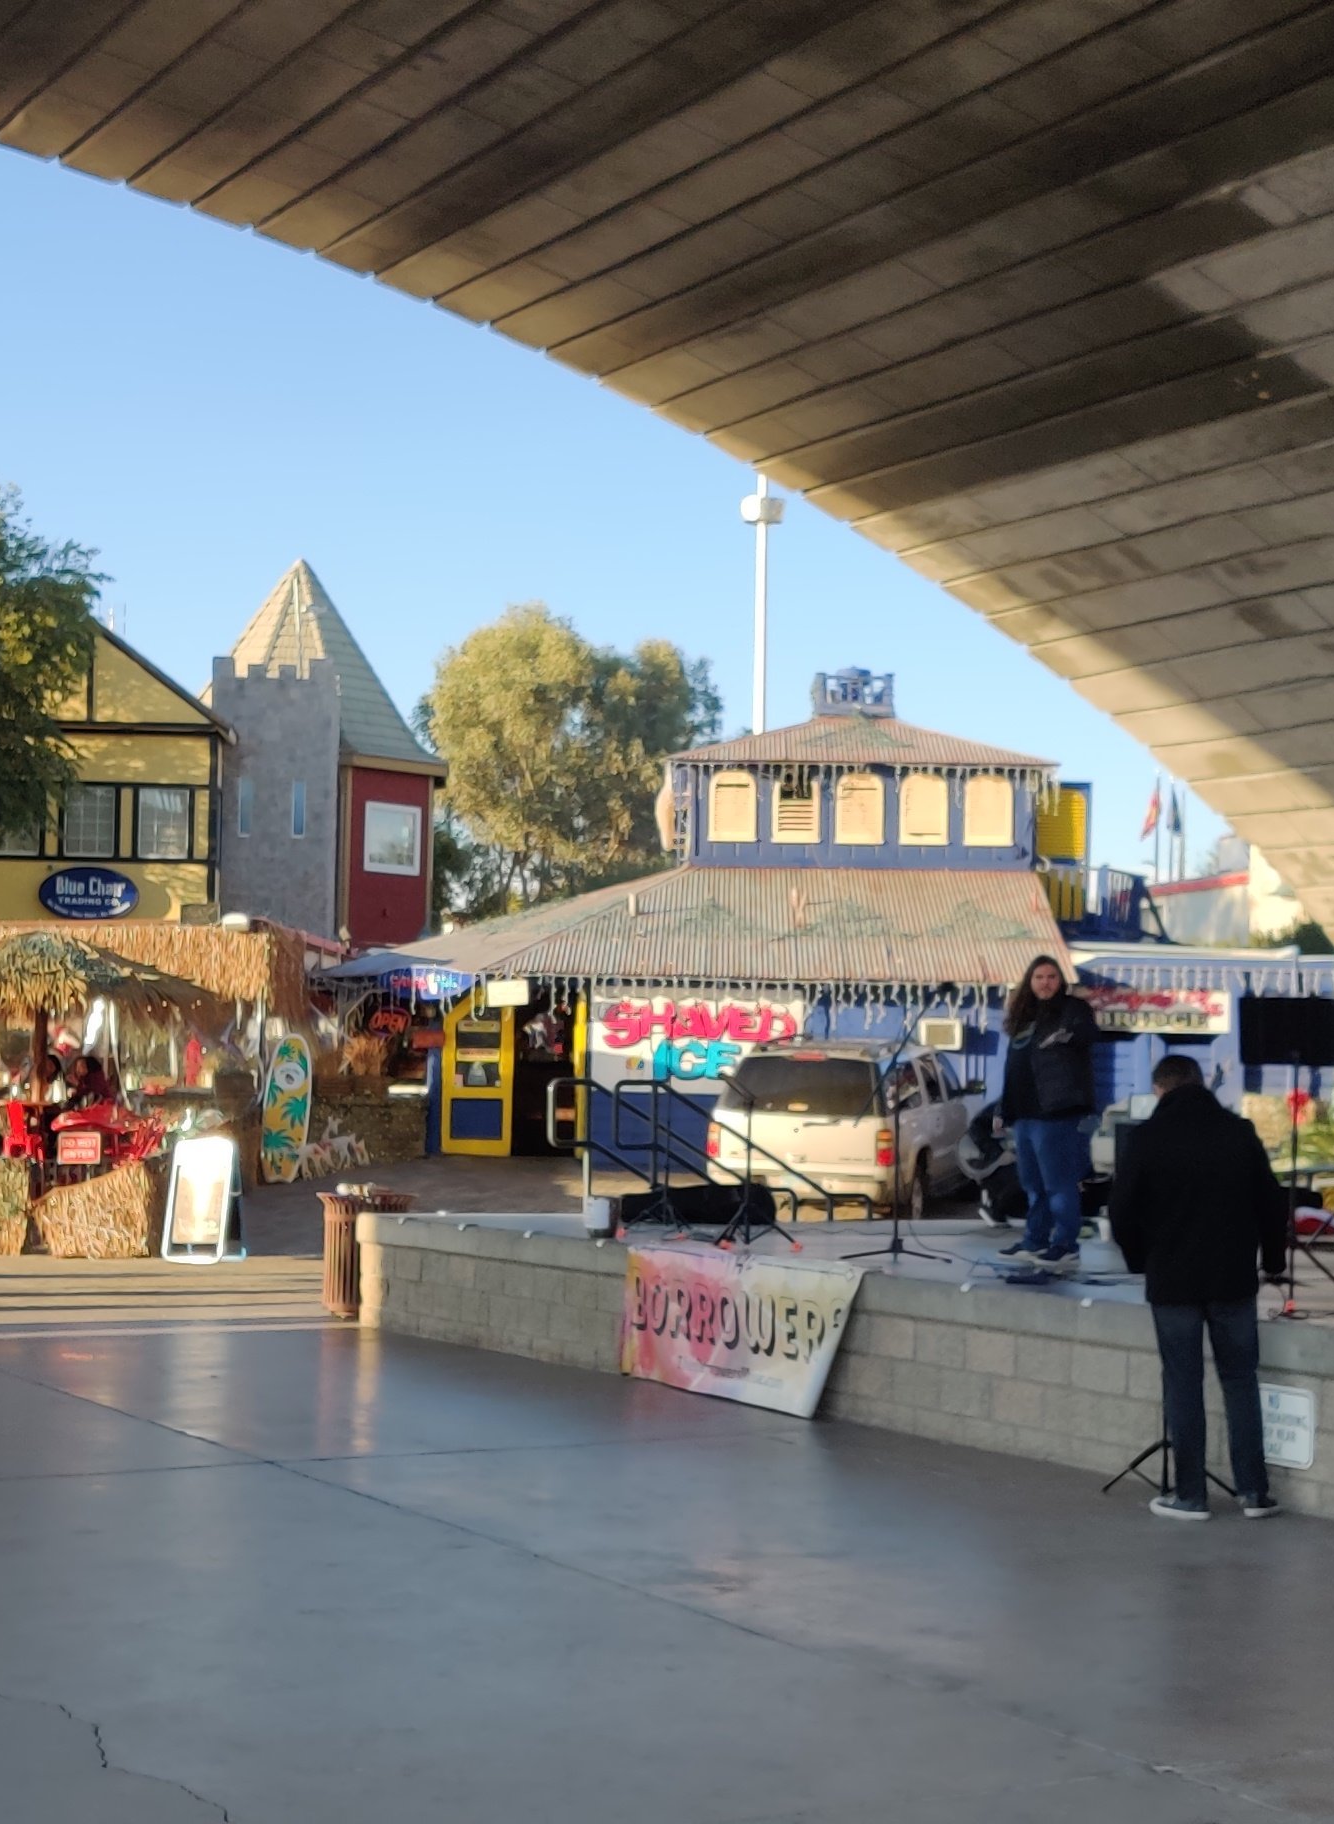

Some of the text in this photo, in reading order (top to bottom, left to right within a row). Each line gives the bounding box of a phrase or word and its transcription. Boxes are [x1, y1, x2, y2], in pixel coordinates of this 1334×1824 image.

[56, 876, 85, 895] Blue
[58, 896, 102, 906] TRADING
[372, 1011, 407, 1034] OPEN
[603, 1000, 796, 1048] SHAVED
[653, 1039, 742, 1082] ICE
